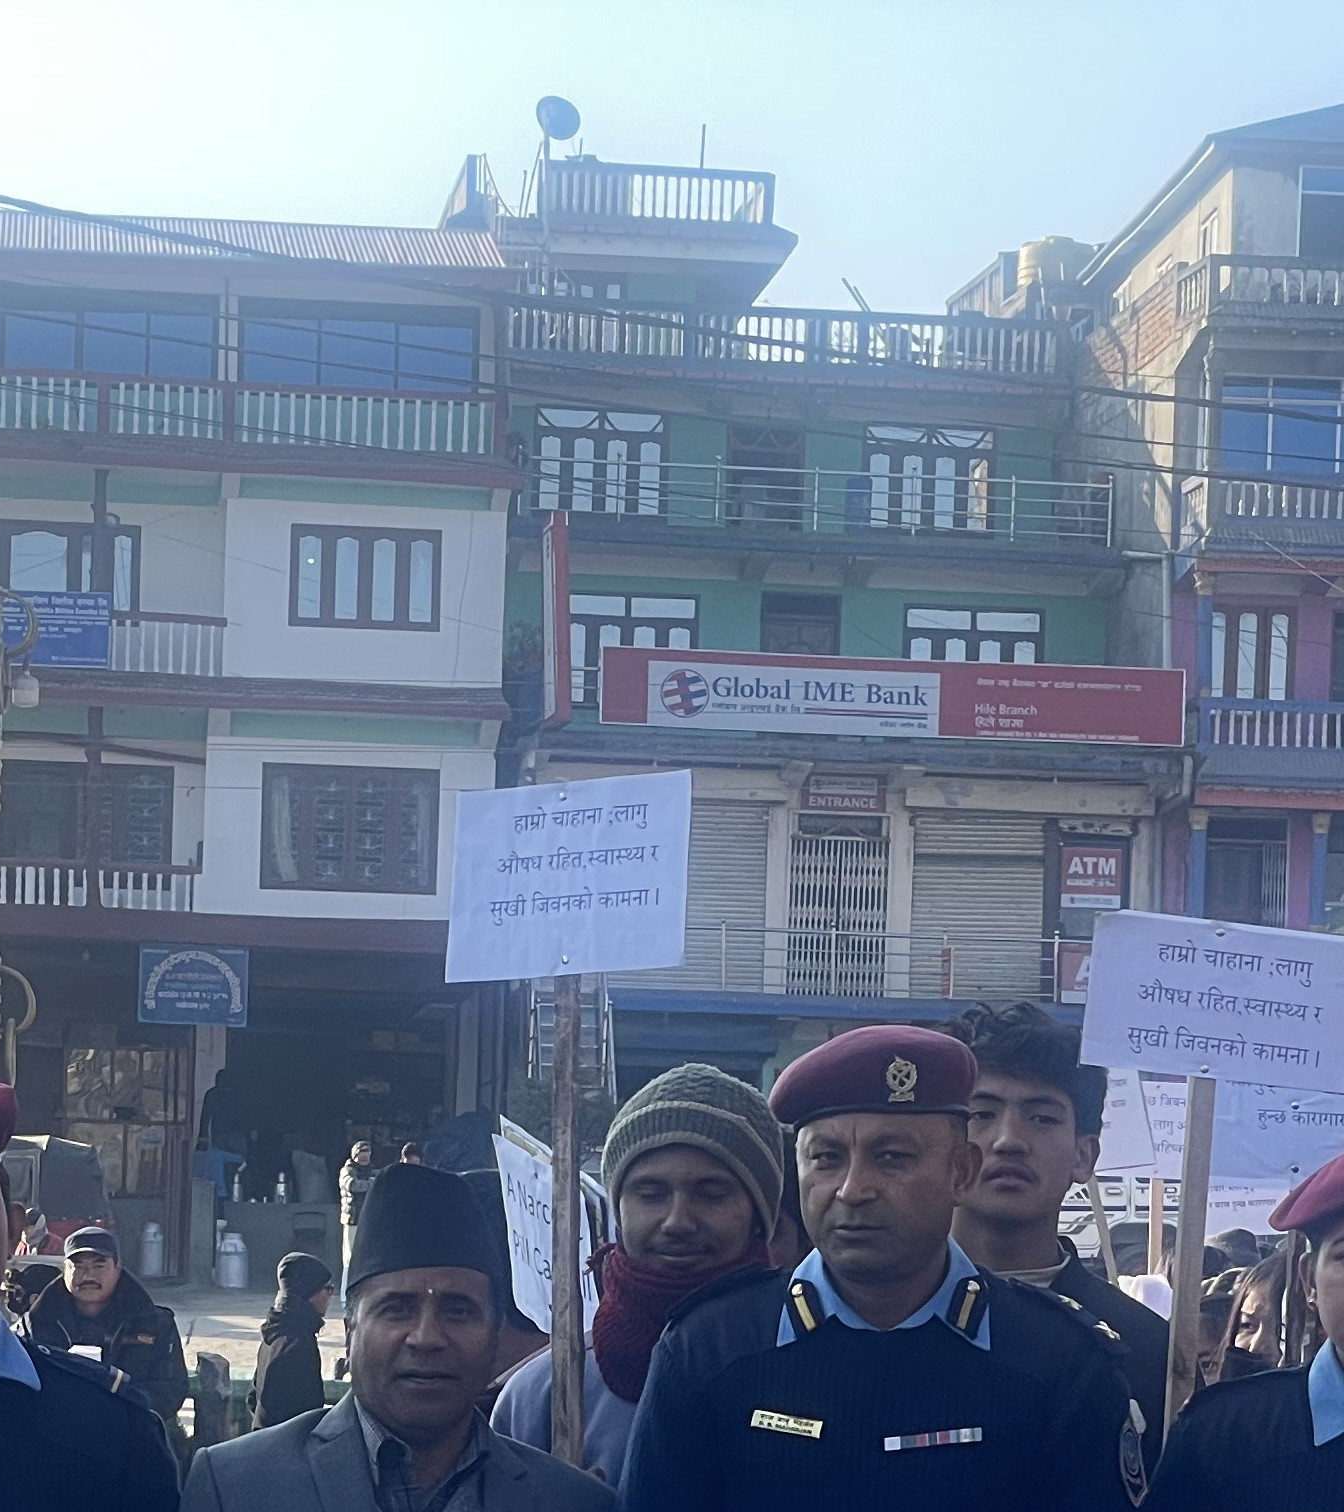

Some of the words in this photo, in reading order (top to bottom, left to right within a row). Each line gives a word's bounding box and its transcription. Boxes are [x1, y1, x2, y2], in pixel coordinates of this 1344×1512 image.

[712, 676, 791, 700] Global
[804, 680, 855, 704] IME
[866, 683, 929, 707] Bank
[974, 703, 997, 716] Hile
[999, 704, 1038, 717] Branch
[808, 796, 878, 809] ENTRANCE
[514, 805, 546, 833] हाम्रो
[552, 807, 604, 828] चाहाना
[650, 845, 660, 862] र
[1067, 856, 1116, 876] ATM
[489, 893, 527, 926] सुखी
[531, 886, 593, 915] जिवनको
[597, 889, 650, 908] कामना
[1158, 940, 1197, 964] हाम्रो
[1203, 948, 1264, 973] चाहाना
[1138, 979, 1191, 1006] औषध
[1313, 1005, 1324, 1025] र
[1127, 1025, 1169, 1055] सुखी
[1175, 1032, 1248, 1059] जिवनको
[1252, 1042, 1311, 1066] कामना
[1257, 1109, 1288, 1130] हुन्छ
[507, 1172, 516, 1203] A
[517, 1179, 552, 1226] Narc
[513, 1228, 531, 1268] Pill
[534, 1246, 554, 1282] Ca
